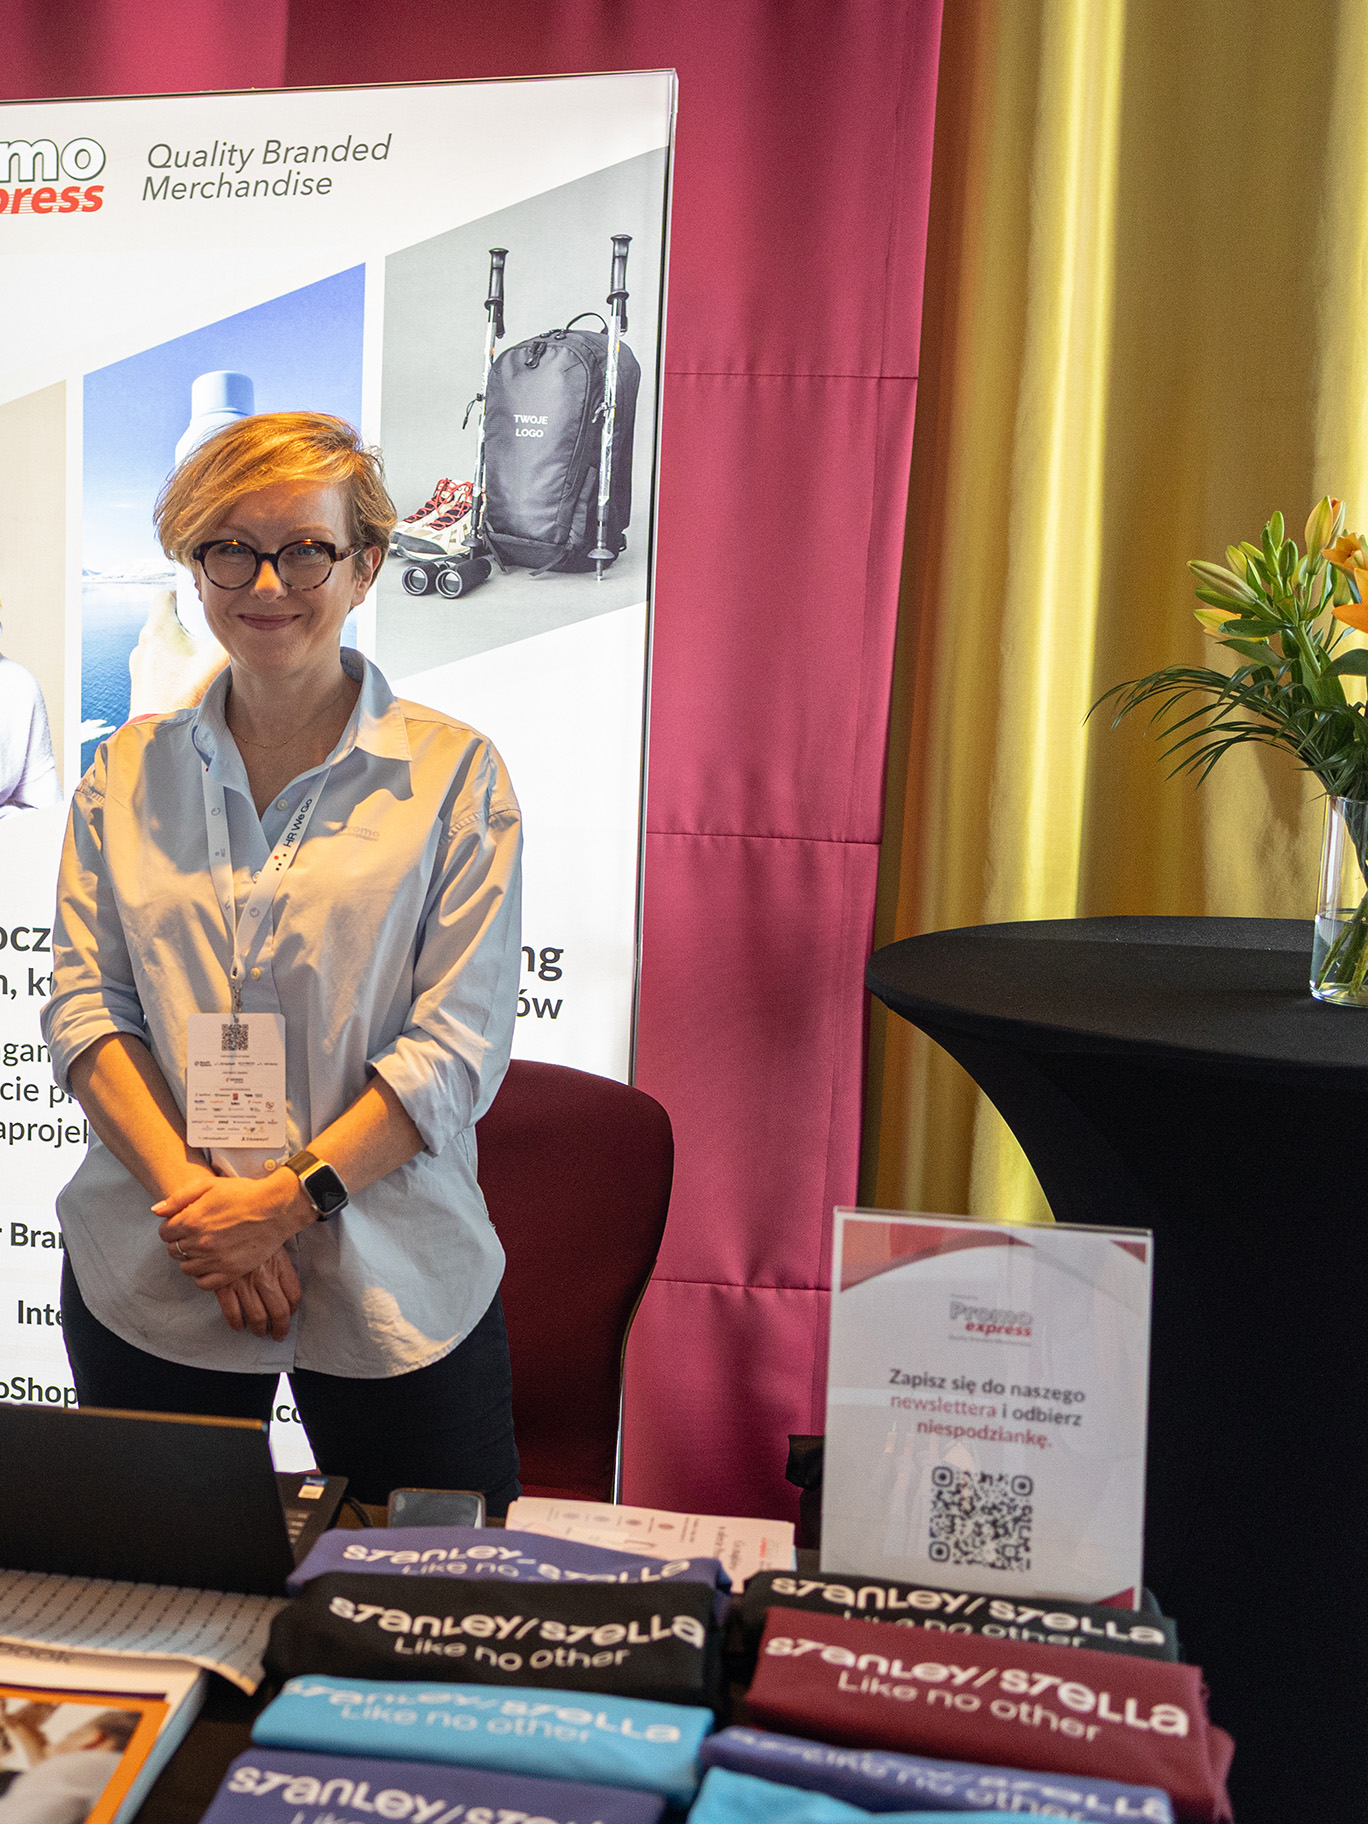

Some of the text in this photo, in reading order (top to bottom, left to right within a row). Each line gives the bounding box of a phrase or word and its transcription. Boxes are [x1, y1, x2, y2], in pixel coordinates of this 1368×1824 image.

[146, 134, 392, 174] Quality Branded
[142, 169, 333, 201] Merchandise
[513, 414, 549, 424] TWOJE
[515, 428, 544, 438] LOGO
[965, 1321, 1032, 1337] express
[889, 1368, 1086, 1405] Zapisz się do naszego
[890, 1395, 997, 1418] newslettera
[1012, 1406, 1083, 1427] odbierz
[916, 1419, 1052, 1449] niespodziankę.
[394, 1636, 631, 1672] Like no other
[837, 1670, 1102, 1743] Like no other
[340, 1704, 591, 1743] Like no other
